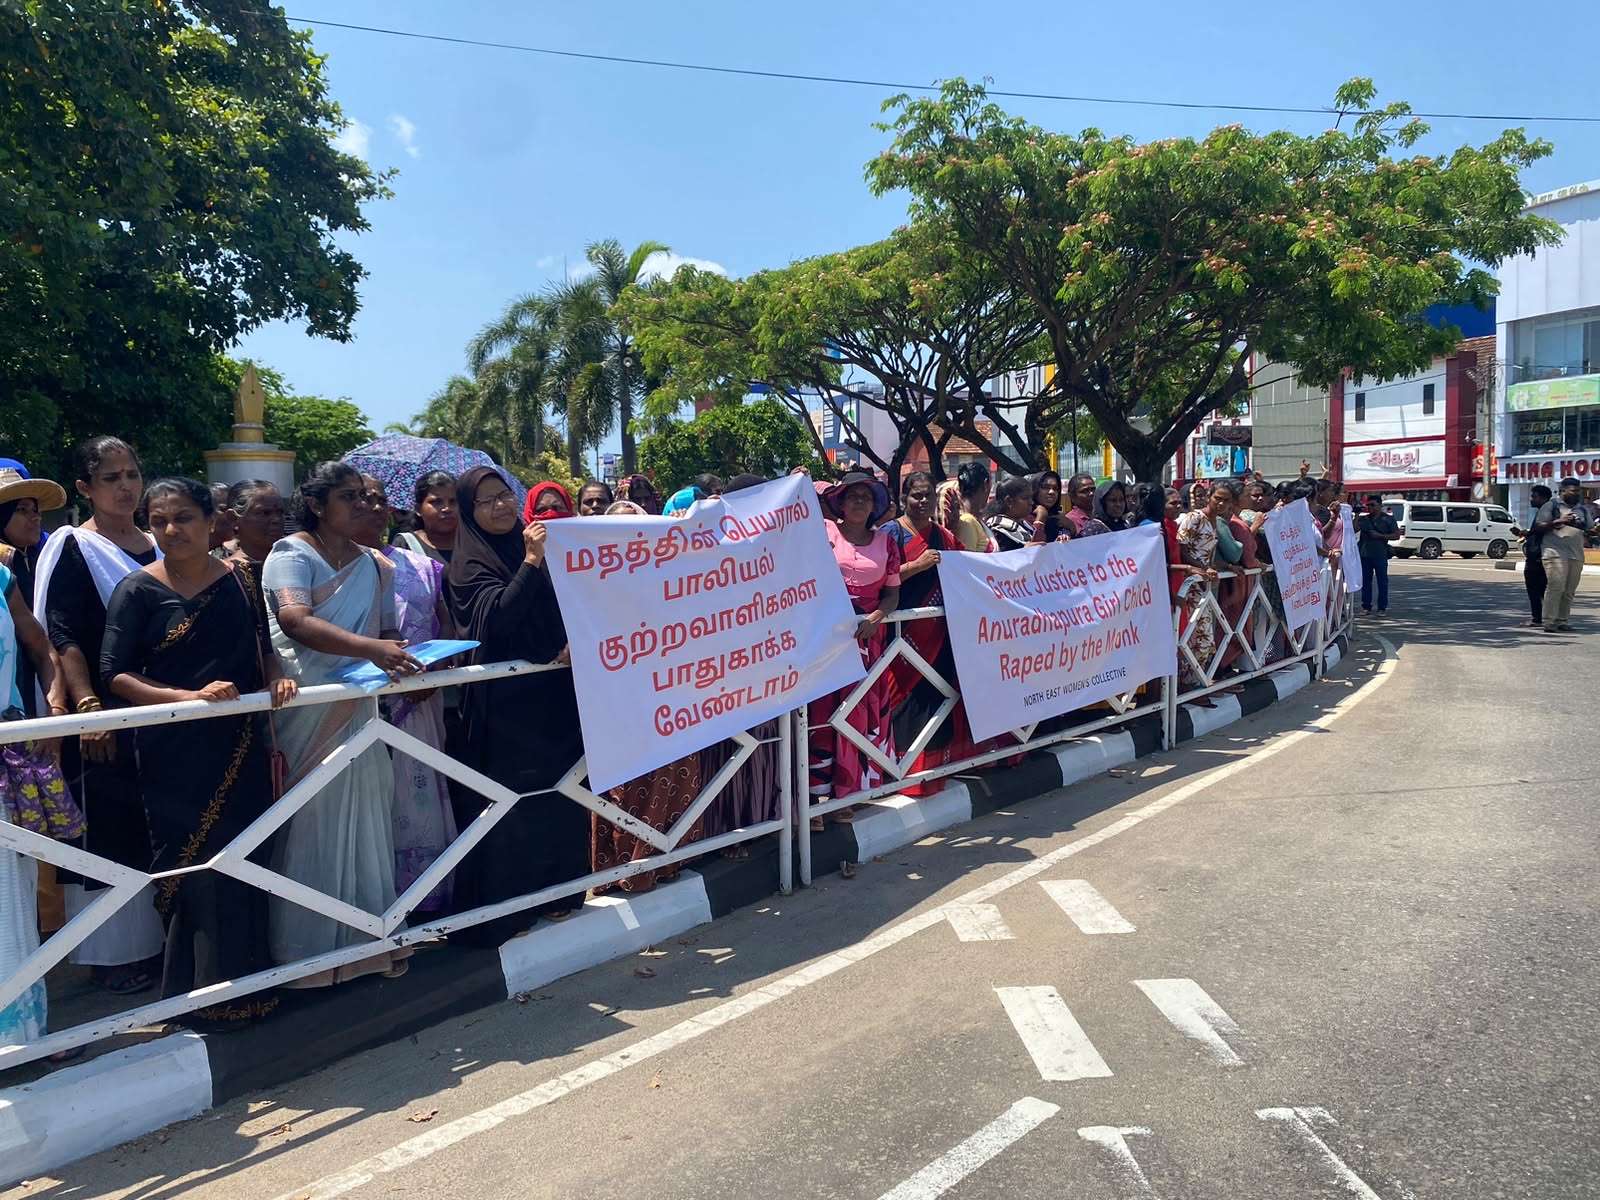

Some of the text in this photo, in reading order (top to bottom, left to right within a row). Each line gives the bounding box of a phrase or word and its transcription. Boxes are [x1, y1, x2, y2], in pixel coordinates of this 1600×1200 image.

[566, 496, 811, 580] மதத்தின் பெயரால்
[663, 547, 775, 601] பாலியல்
[986, 553, 1139, 600] Grant Justice to the
[599, 578, 818, 672] குற்றவாளிகளை
[976, 580, 1152, 645] Anuradhapura Girl Child
[652, 630, 797, 692] பாதுகாக்க
[999, 620, 1141, 683] Raped by the Monk
[654, 665, 800, 737] வேண்டாம்
[1023, 690, 1044, 708] NORTH
[1046, 687, 1060, 700] EAST
[1091, 666, 1127, 686] COLLECTIVE
